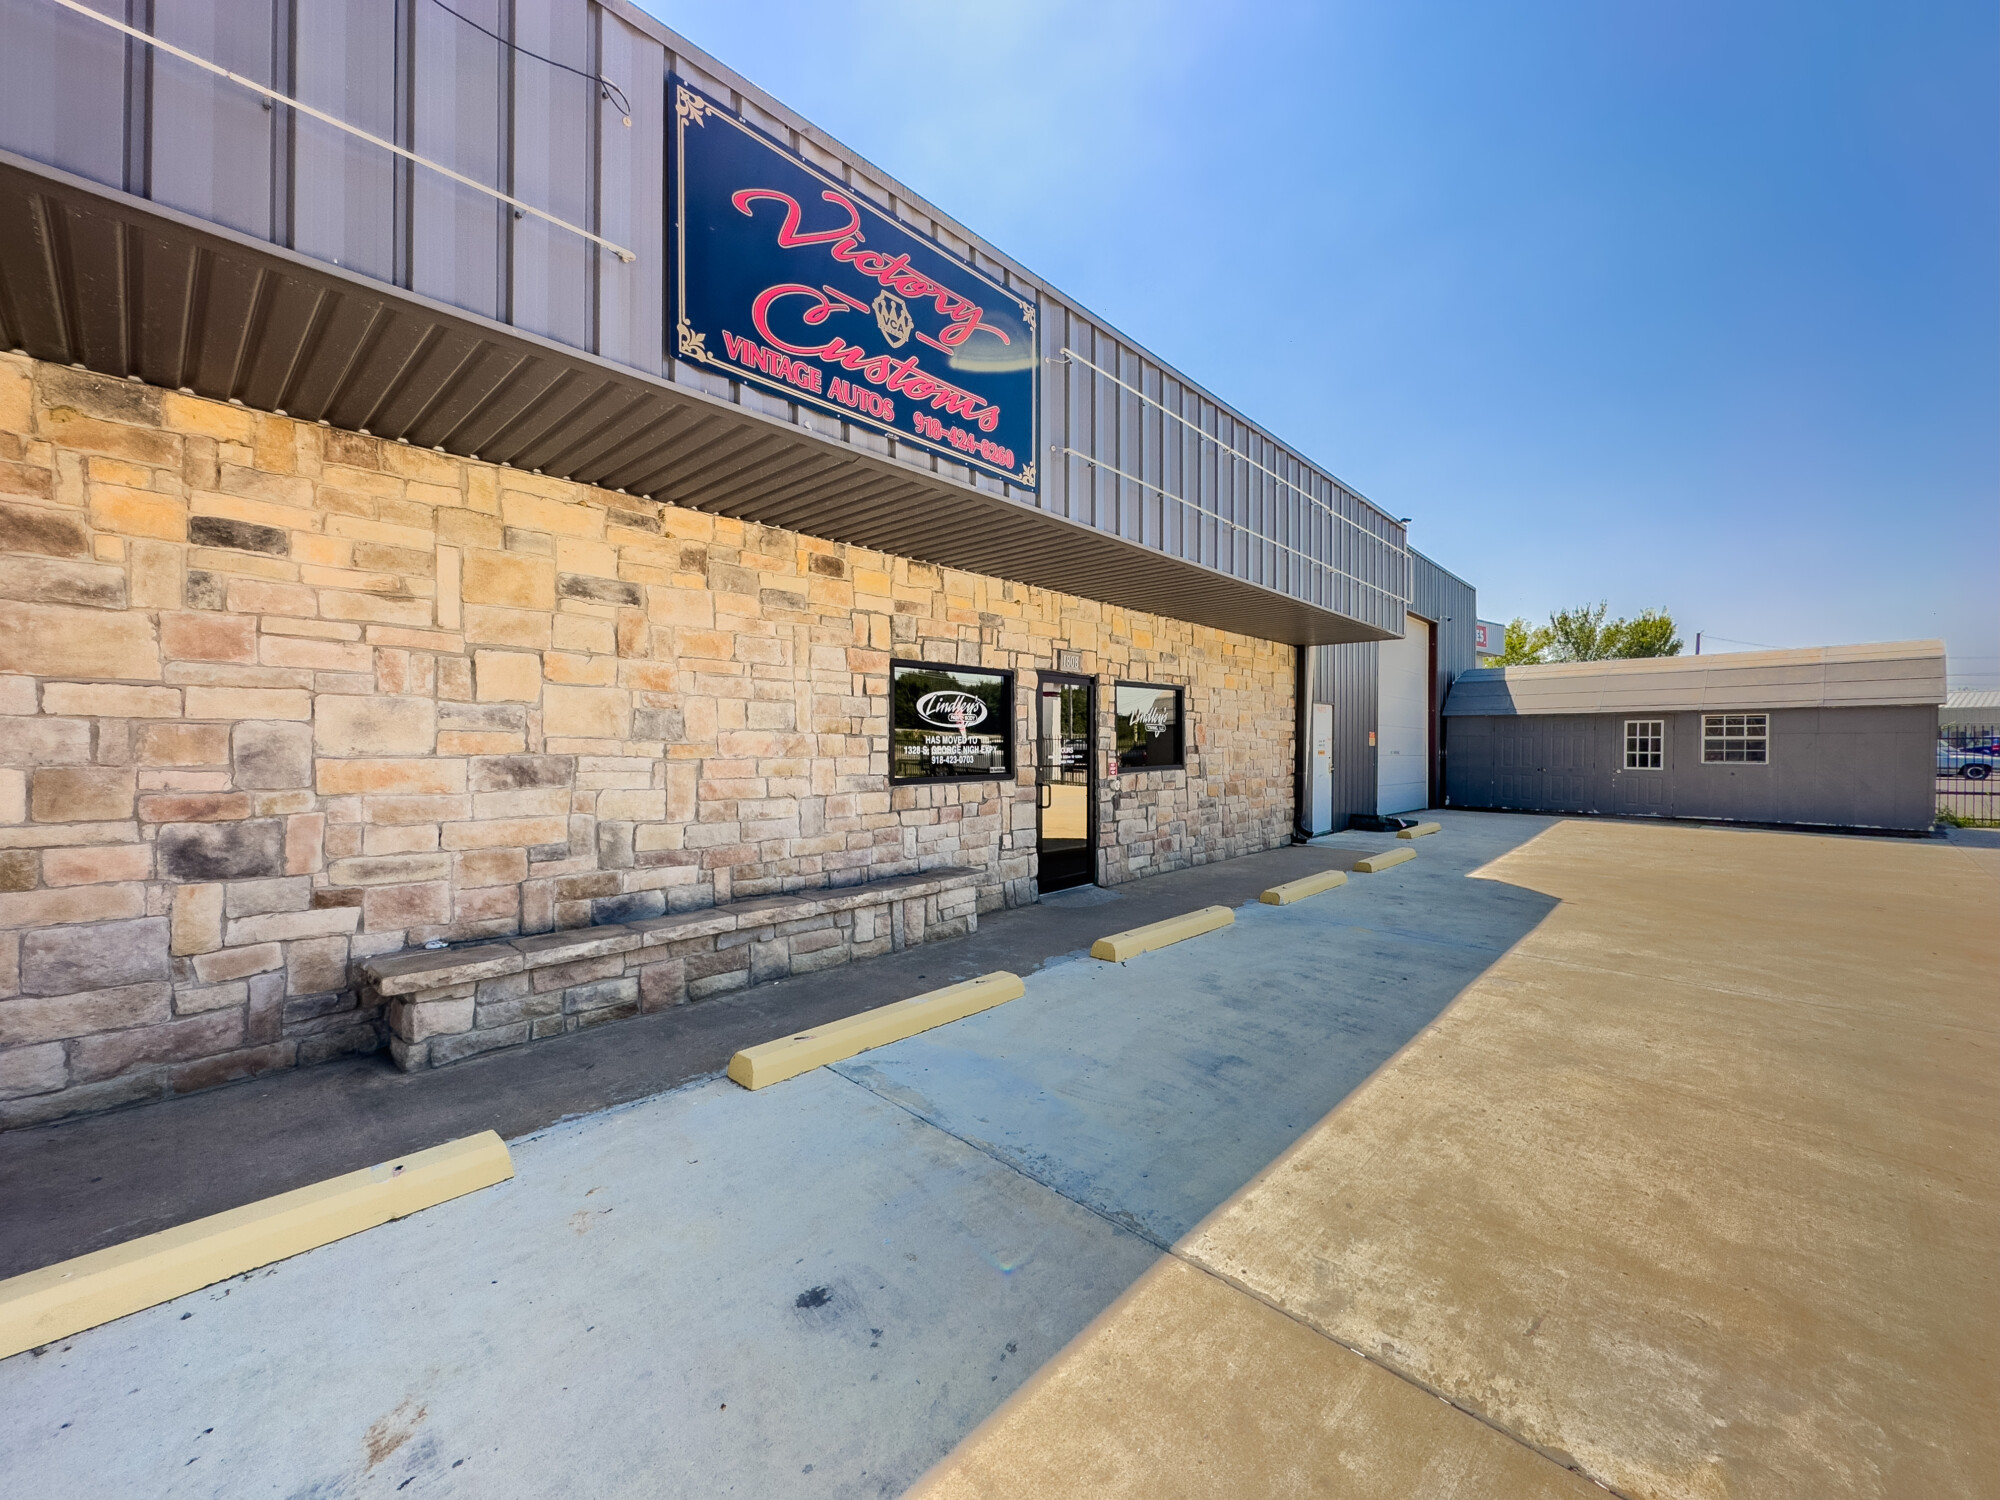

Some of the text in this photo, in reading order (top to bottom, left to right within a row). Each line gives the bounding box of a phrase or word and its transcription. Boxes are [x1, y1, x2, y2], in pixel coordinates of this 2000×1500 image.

[732, 188, 1010, 346] Victory
[883, 314, 904, 334] VCA
[752, 283, 999, 432] Customs
[722, 329, 1014, 469] VINTAGE AUTOS 918-424-8260
[1063, 655, 1079, 668] 1808
[925, 694, 980, 726] Lindley's
[925, 735, 978, 744] HAS MOVED TO
[904, 746, 920, 755] 1328
[931, 745, 962, 755] GEORGE
[963, 745, 979, 754] NIGH
[932, 755, 974, 765] 918-423-0703
